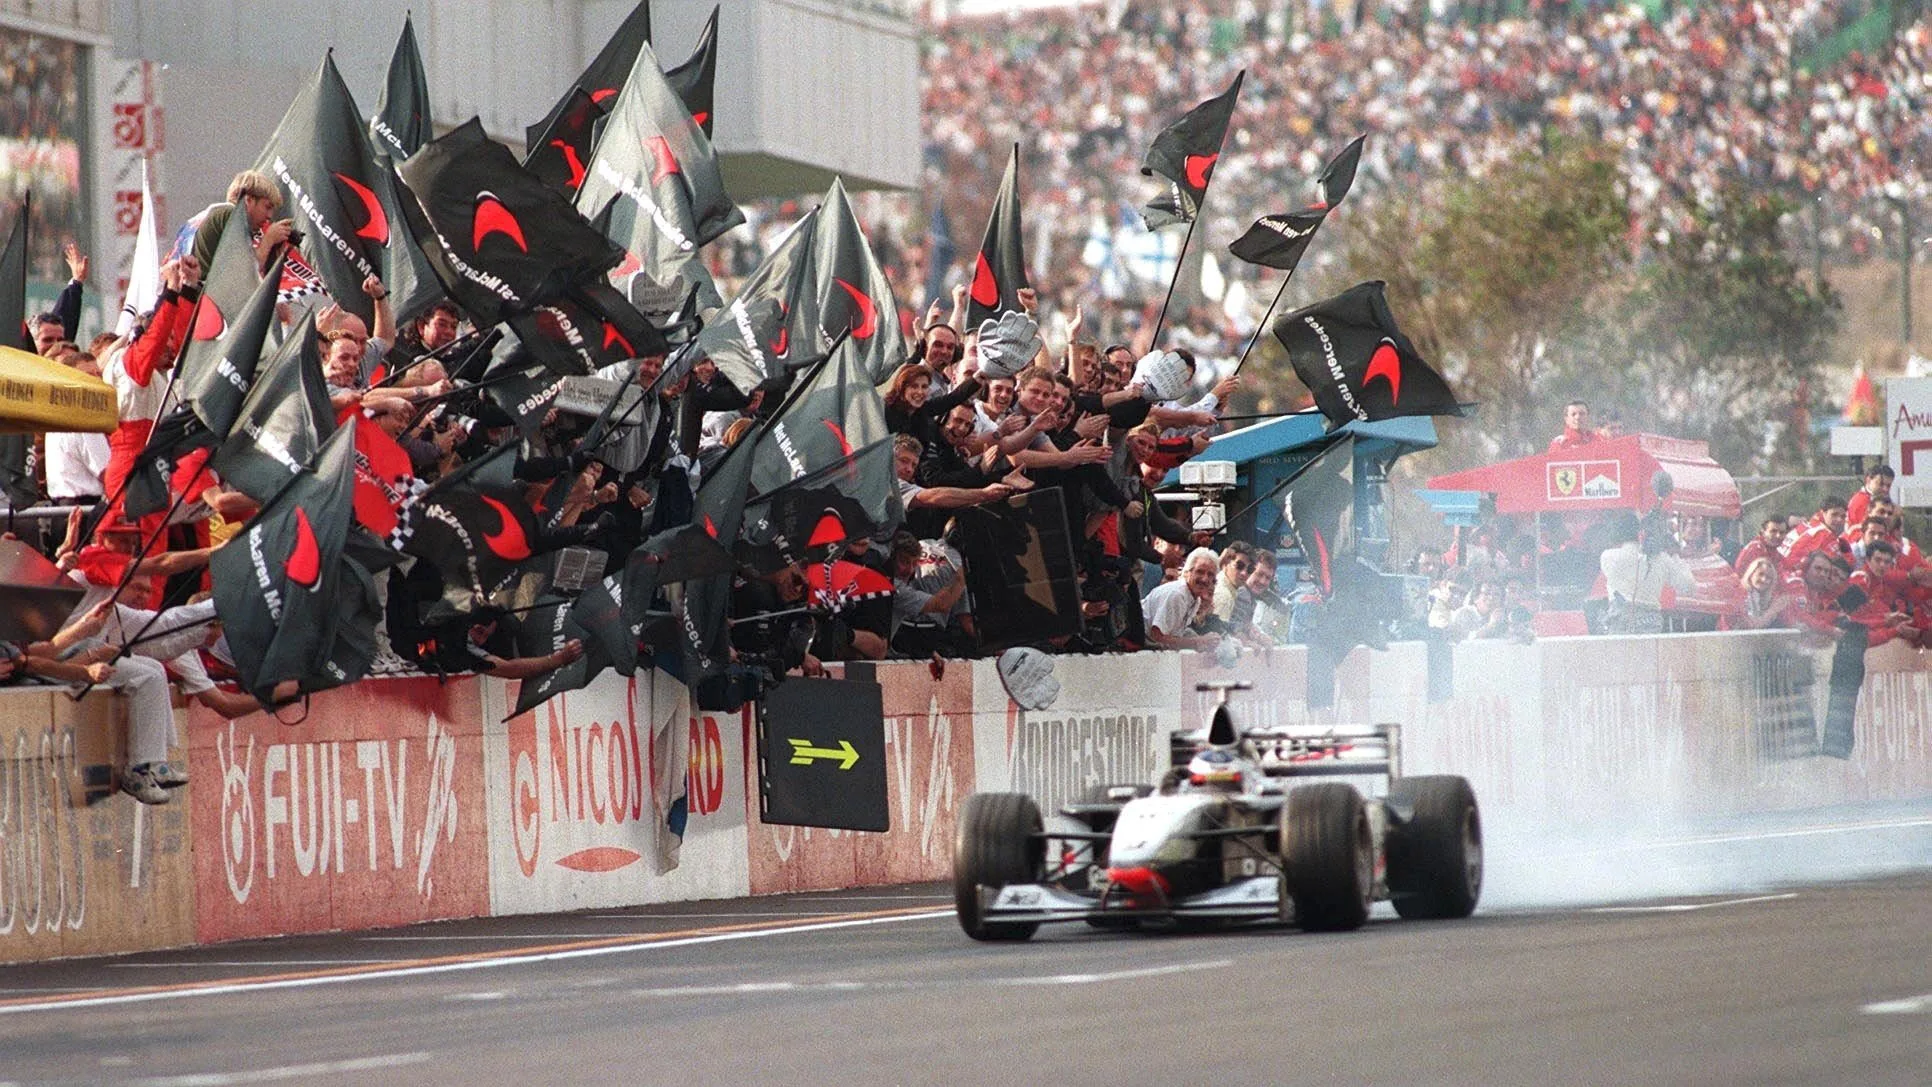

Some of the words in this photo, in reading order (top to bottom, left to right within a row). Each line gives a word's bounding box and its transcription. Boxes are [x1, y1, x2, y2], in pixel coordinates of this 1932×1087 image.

[300, 195, 356, 261] McLaren
[1584, 481, 1619, 498] Marlboro
[264, 739, 407, 879] FUJI-TV
